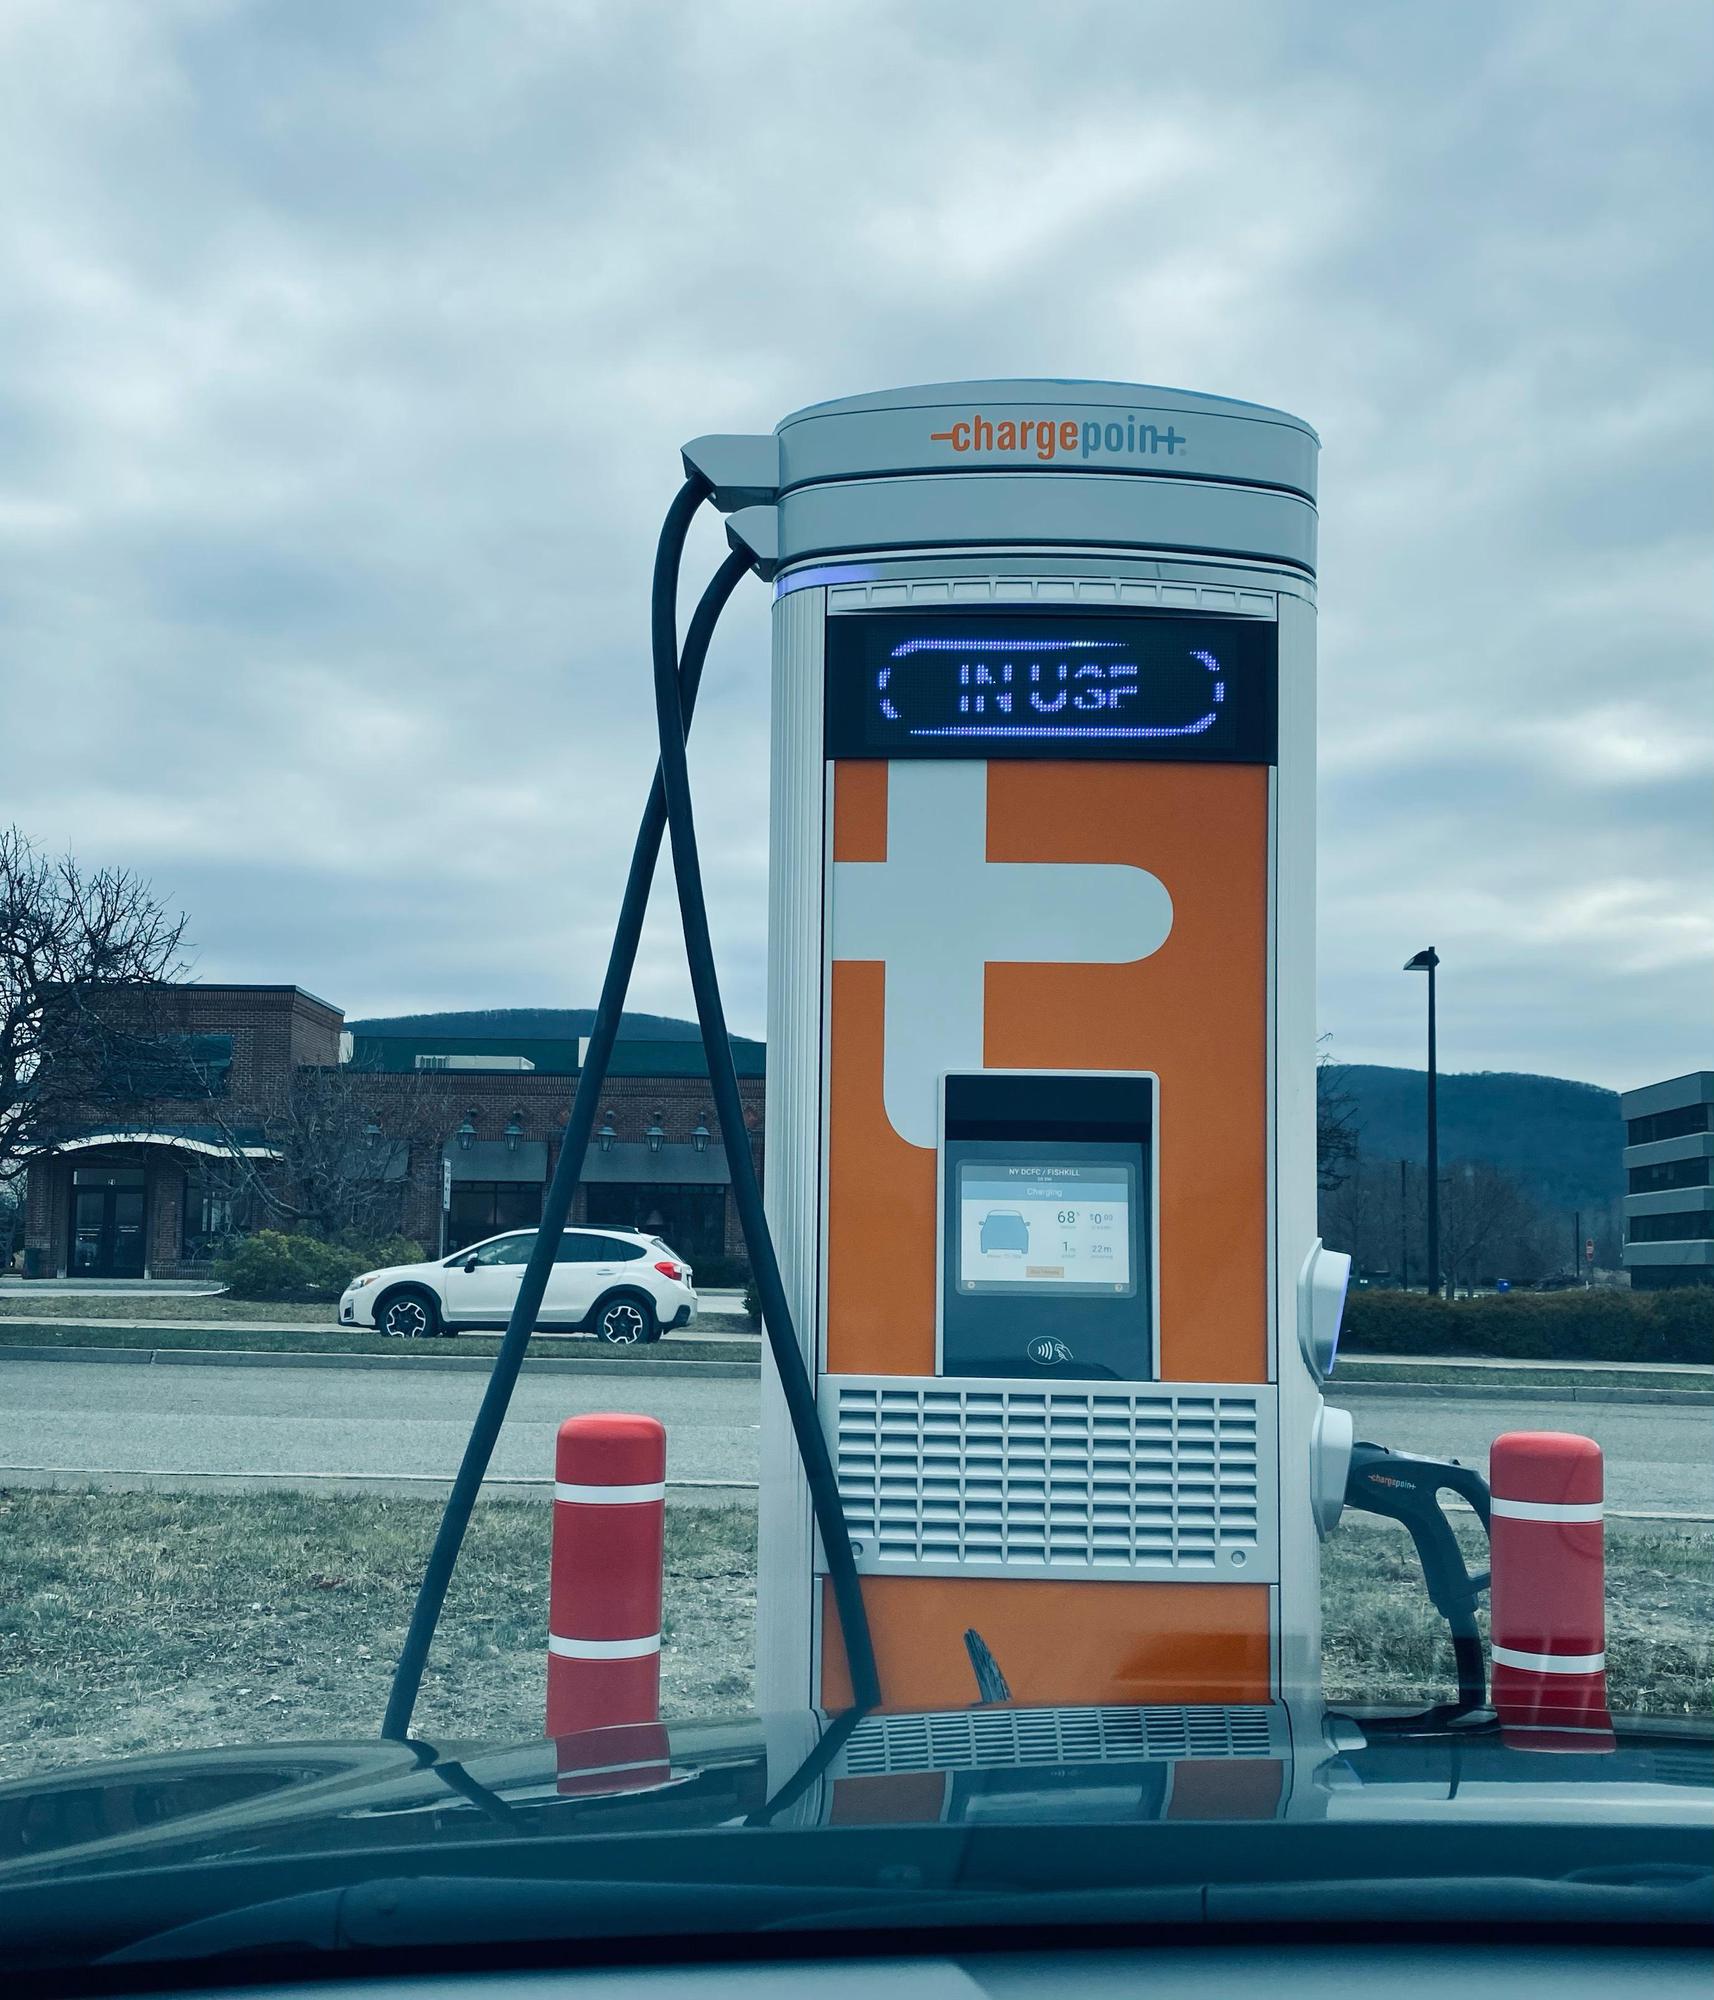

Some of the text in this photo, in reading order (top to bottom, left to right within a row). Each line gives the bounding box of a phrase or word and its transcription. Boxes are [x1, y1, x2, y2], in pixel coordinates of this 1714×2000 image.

[960, 664, 1013, 713] IN
[1008, 1168, 1020, 1176] NY
[1021, 1168, 1041, 1176] DCFC
[1047, 1168, 1081, 1177] FISHKILL
[1026, 1187, 1063, 1198] Charging
